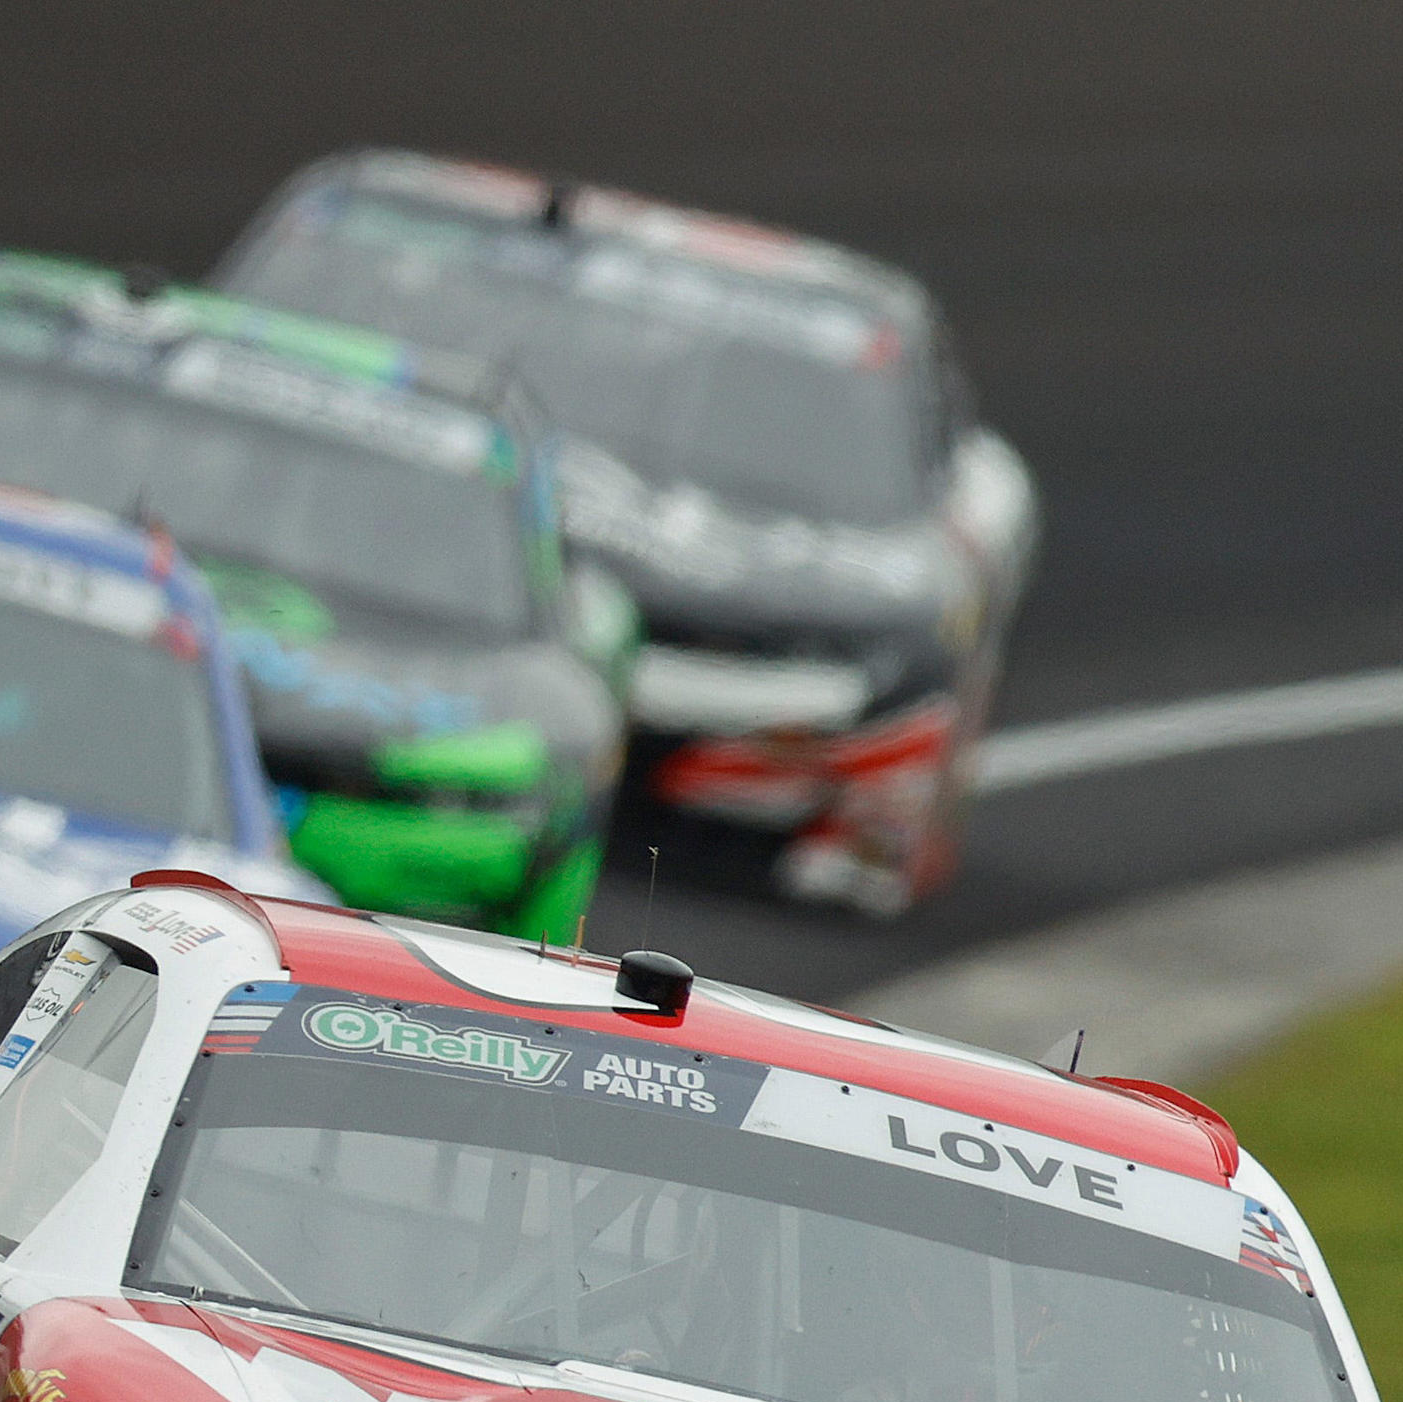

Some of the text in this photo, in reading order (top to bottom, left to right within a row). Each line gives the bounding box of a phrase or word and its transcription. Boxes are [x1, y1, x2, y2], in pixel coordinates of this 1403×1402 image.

[44, 1001, 64, 1016] OIL
[308, 1006, 554, 1079] O'Reilly
[582, 1069, 717, 1115] PARTS
[595, 1052, 706, 1090] AUTO
[887, 1112, 1126, 1211] LOVE
